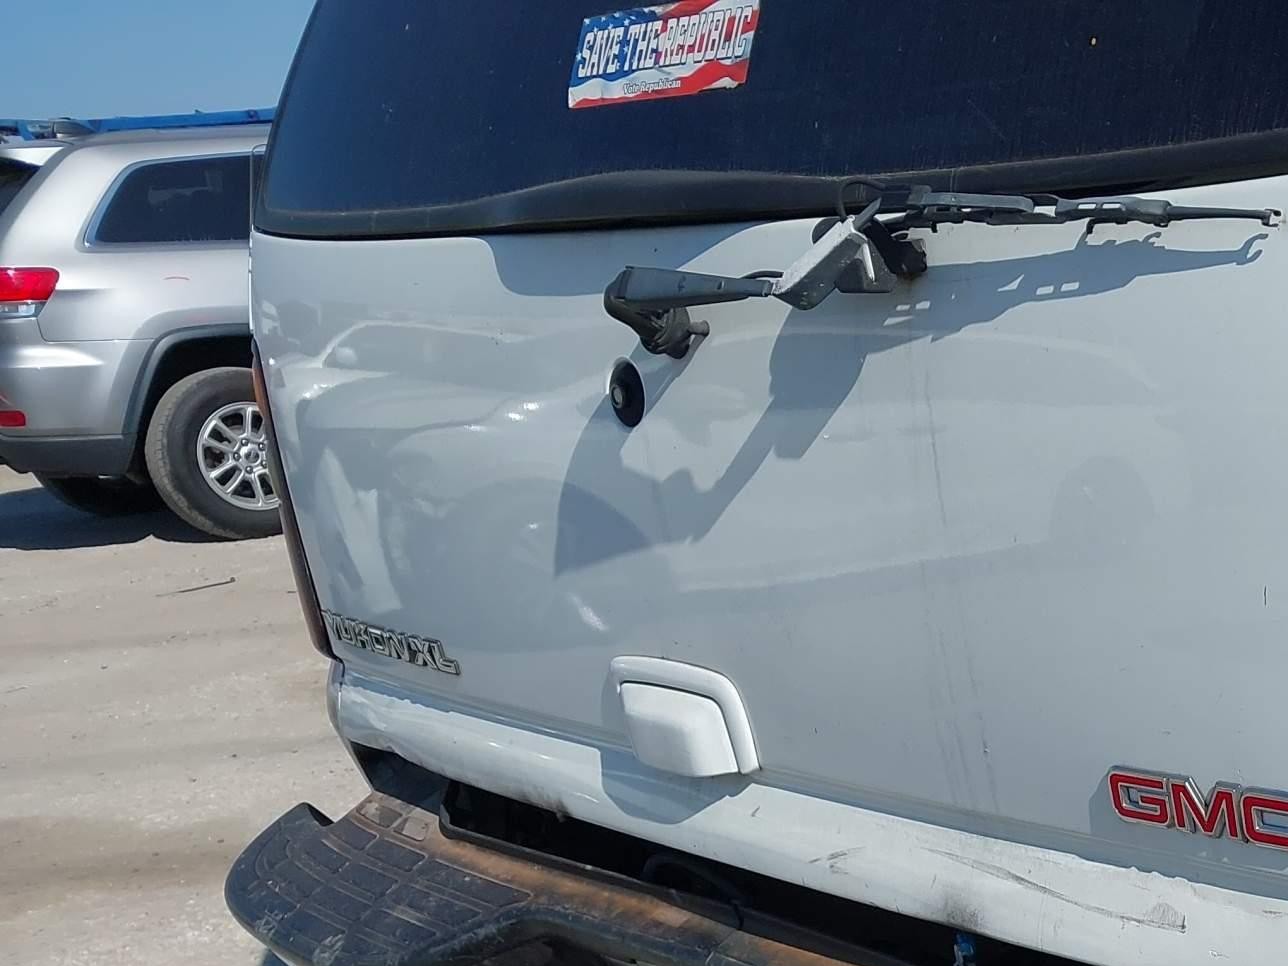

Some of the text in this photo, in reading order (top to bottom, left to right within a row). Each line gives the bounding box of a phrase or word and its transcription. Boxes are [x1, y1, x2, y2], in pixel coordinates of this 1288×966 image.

[577, 6, 754, 78] SAVE THE REPUBLIC
[623, 78, 681, 95] Vote Republican
[320, 609, 461, 676] YUKON XL
